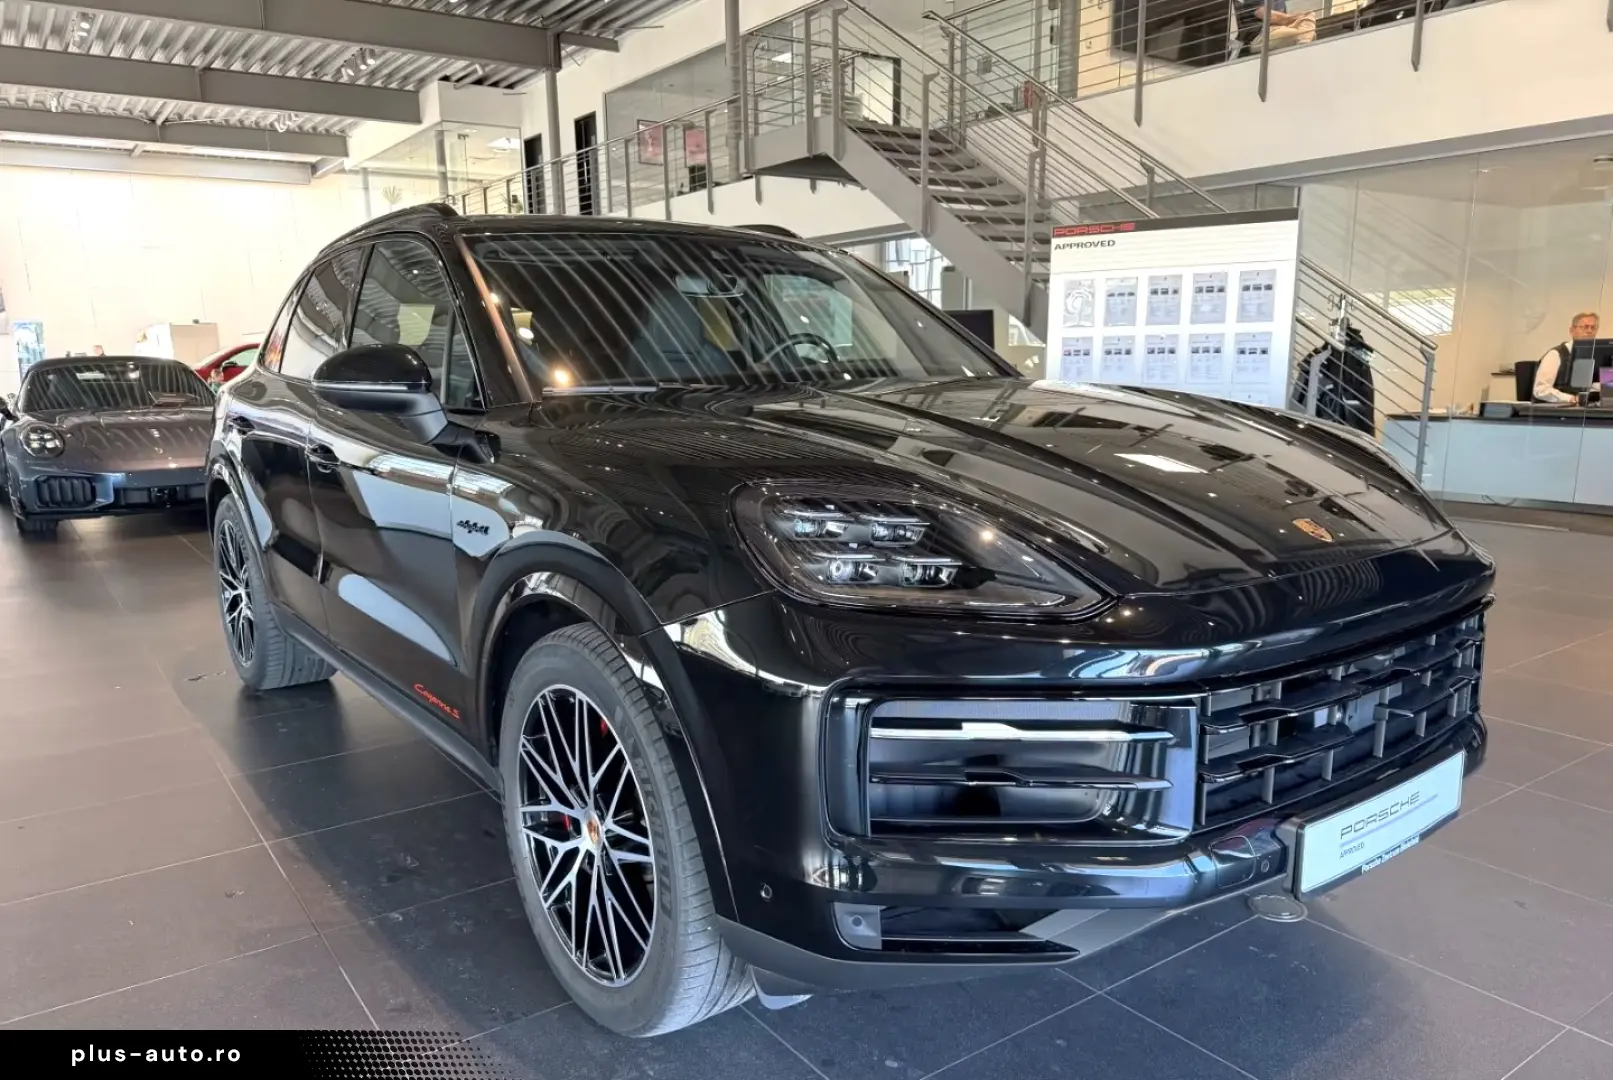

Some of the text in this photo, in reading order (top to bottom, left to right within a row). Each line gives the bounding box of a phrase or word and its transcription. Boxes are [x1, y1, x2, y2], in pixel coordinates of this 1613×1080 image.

[1053, 222, 1136, 237] PORSCHE
[1054, 239, 1116, 251] APPROVED
[1340, 790, 1421, 840] PORSCHE
[634, 757, 671, 909] MICHELIN
